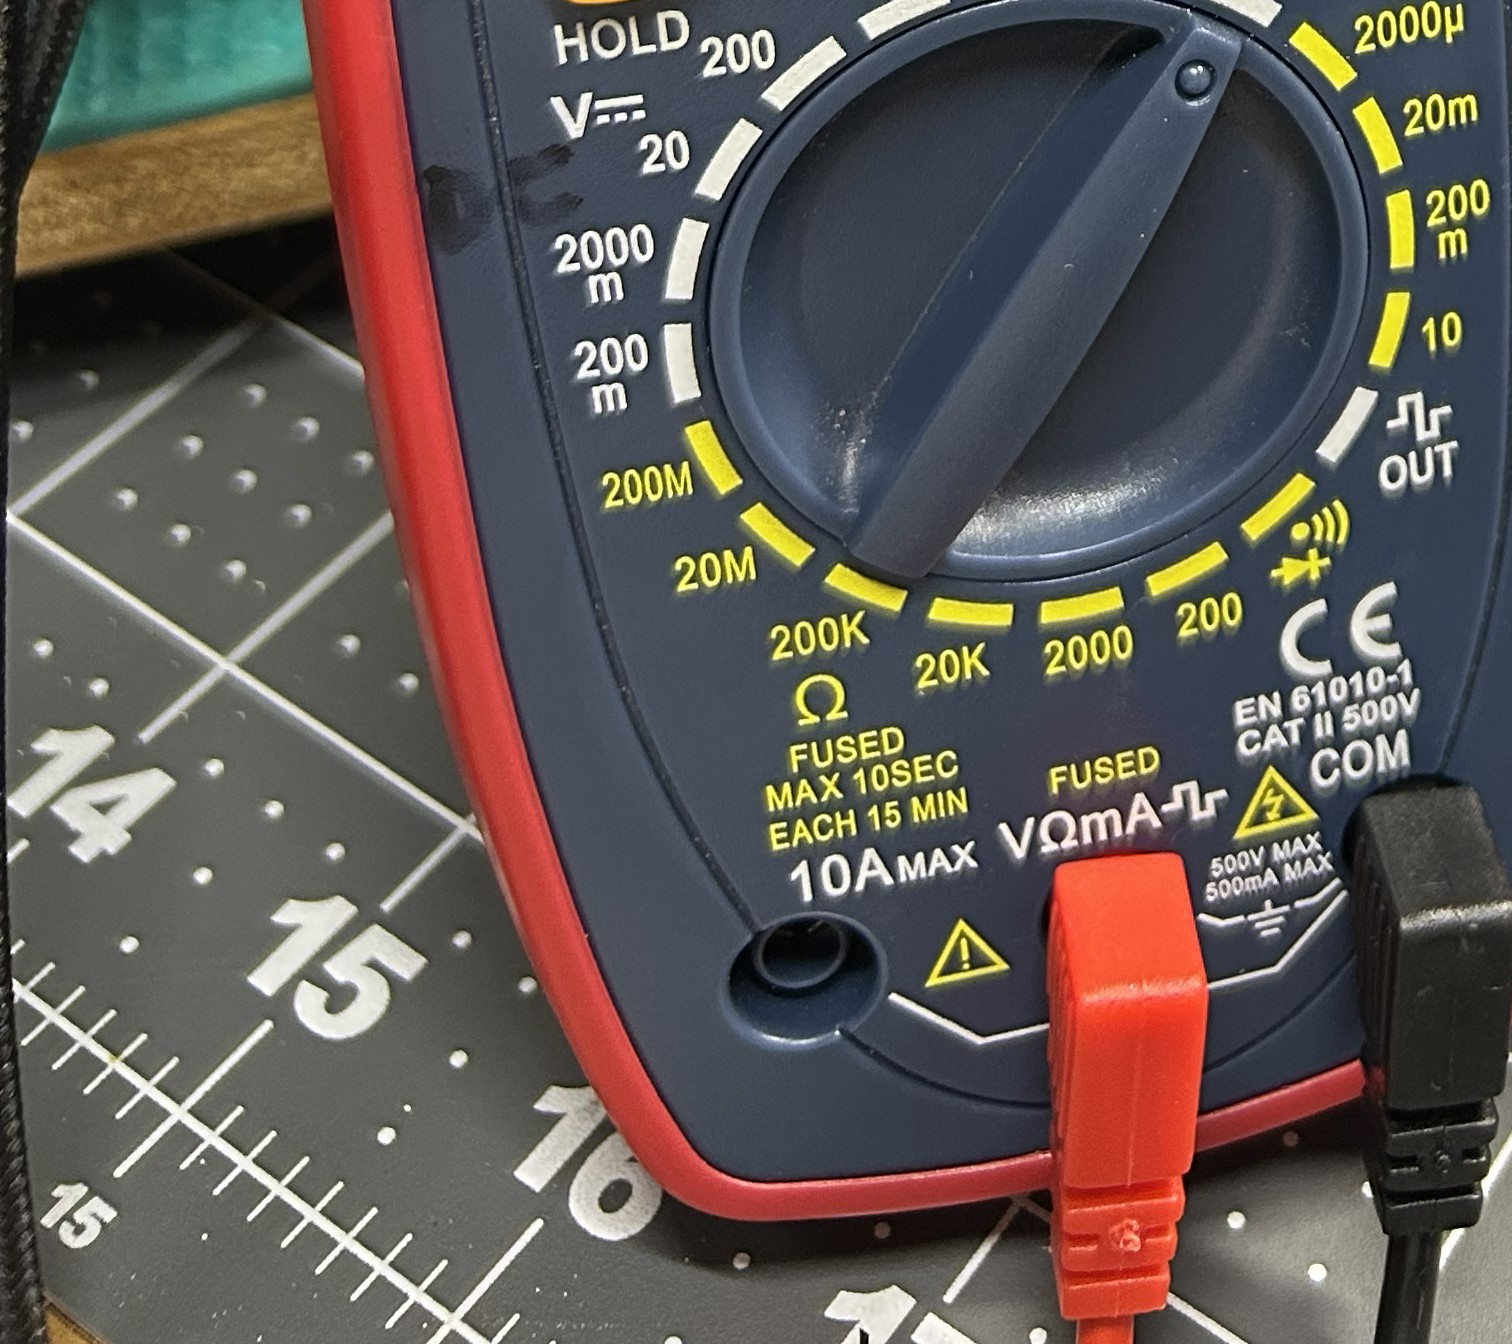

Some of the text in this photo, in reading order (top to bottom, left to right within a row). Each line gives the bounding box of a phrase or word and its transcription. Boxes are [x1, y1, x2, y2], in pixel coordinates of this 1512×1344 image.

[553, 9, 691, 66] HOLD
[699, 28, 777, 78] 200
[1402, 92, 1480, 139] 20m
[638, 129, 691, 176] 20
[1426, 178, 1491, 229] 200
[553, 223, 655, 275] 2000
[1437, 226, 1470, 261] m
[587, 270, 626, 305] m
[572, 333, 650, 381] 200
[1420, 310, 1465, 355] 10
[591, 379, 628, 415] m
[602, 460, 694, 510] 200M
[1378, 440, 1460, 494] OUT
[674, 545, 758, 594] 20M
[769, 610, 871, 662] 200K
[1176, 592, 1243, 640] 200
[913, 641, 991, 691] 20K
[1043, 623, 1135, 678] 2000
[1234, 658, 1414, 728] EN 61010-1
[1236, 686, 1422, 758] CAT II 500V
[788, 726, 906, 774] FUSED
[1048, 744, 1162, 798] FUSED
[1310, 728, 1412, 789] COM
[5, 724, 177, 864] 14
[764, 749, 959, 813] MAX 10SEC
[768, 786, 970, 852] EACH 15 MIN
[1204, 850, 1335, 903] 500mA MAX
[1209, 830, 1324, 879] 500V MAX
[246, 894, 429, 1040] 15
[513, 1085, 665, 1242] 16
[39, 1182, 119, 1250] 15
